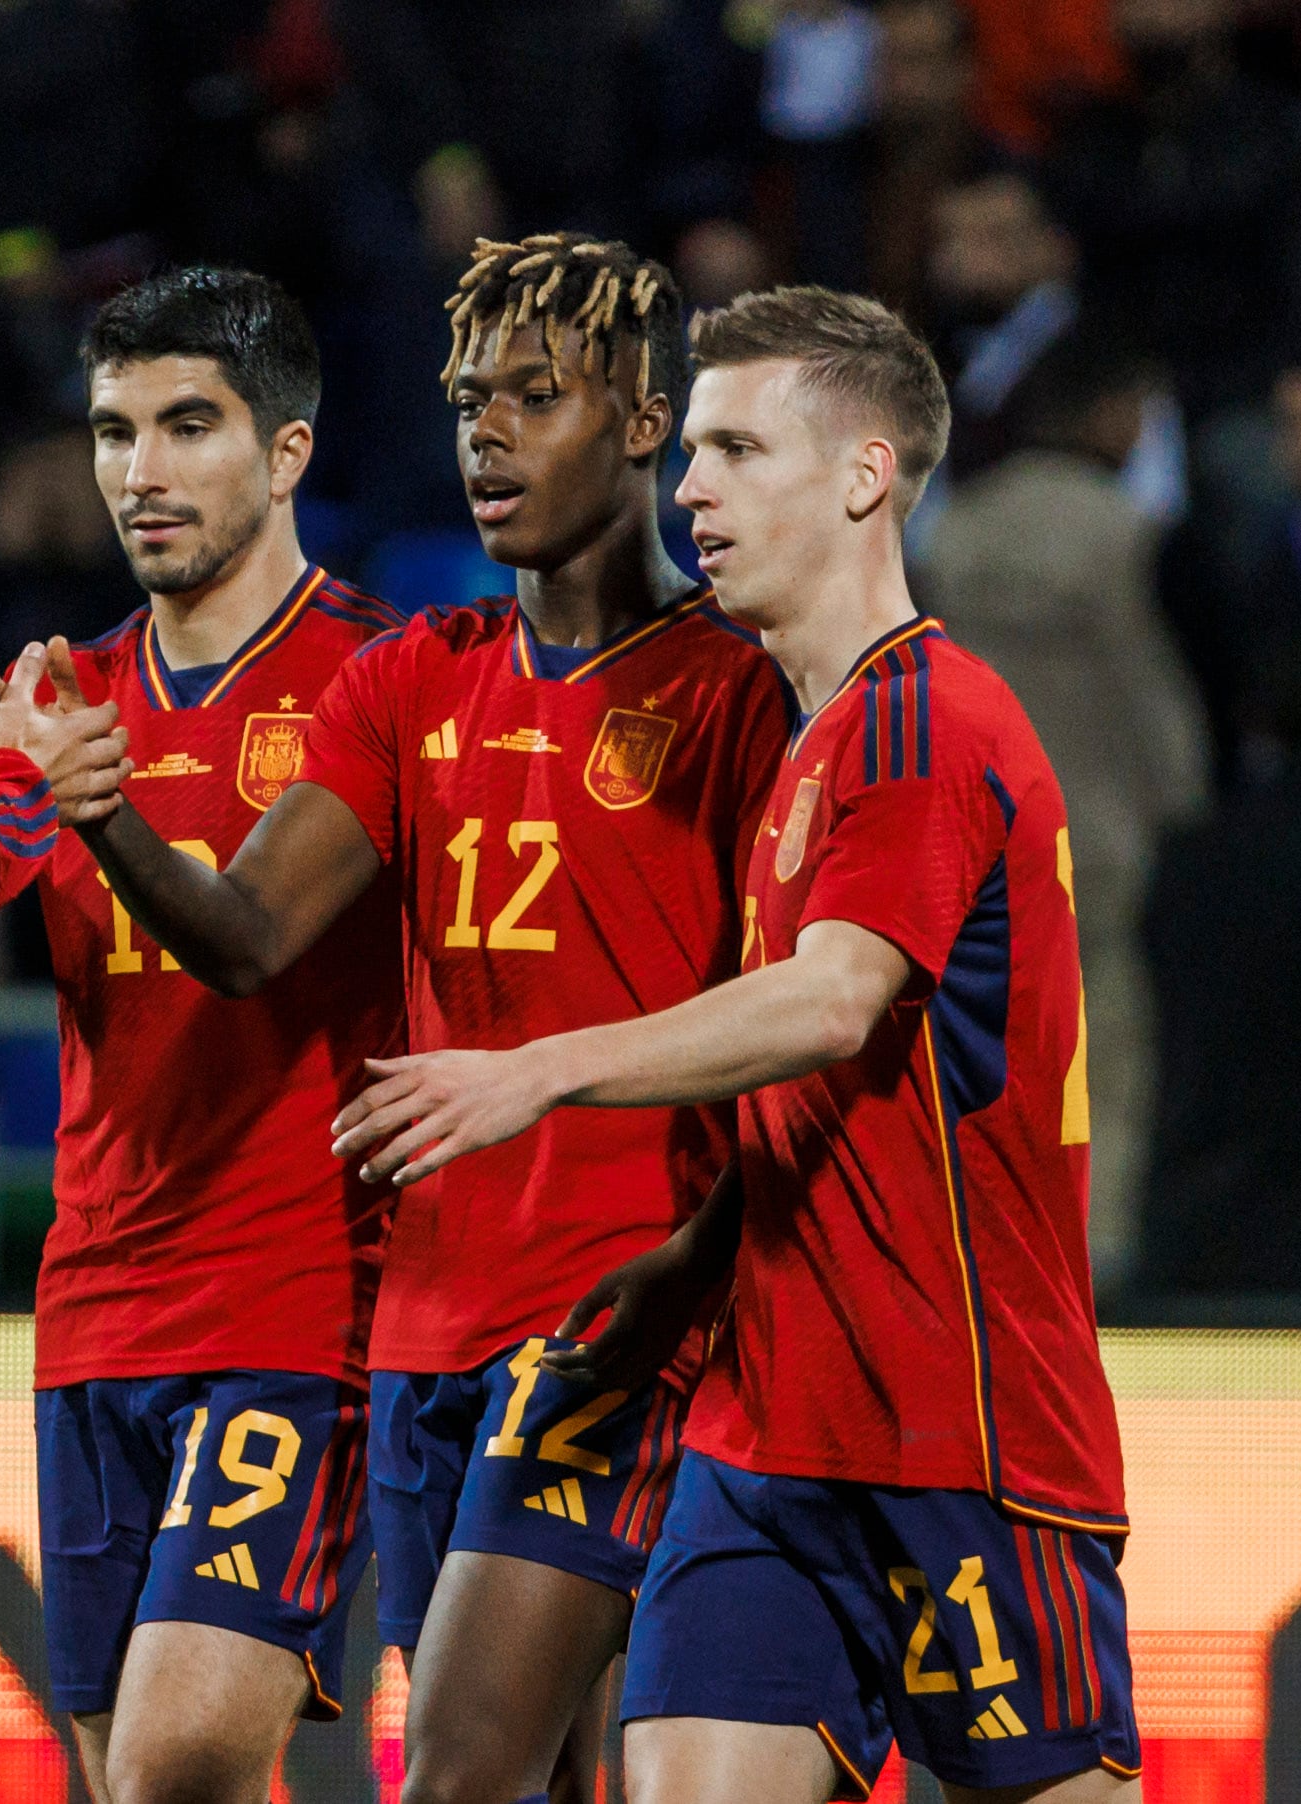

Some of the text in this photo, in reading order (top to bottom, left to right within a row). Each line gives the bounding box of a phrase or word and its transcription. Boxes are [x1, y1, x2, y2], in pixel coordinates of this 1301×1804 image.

[96, 839, 217, 974] 1
[444, 818, 560, 952] 12
[159, 1407, 301, 1530] 19
[484, 1338, 629, 1476] 12
[888, 1555, 1019, 1694] 21
